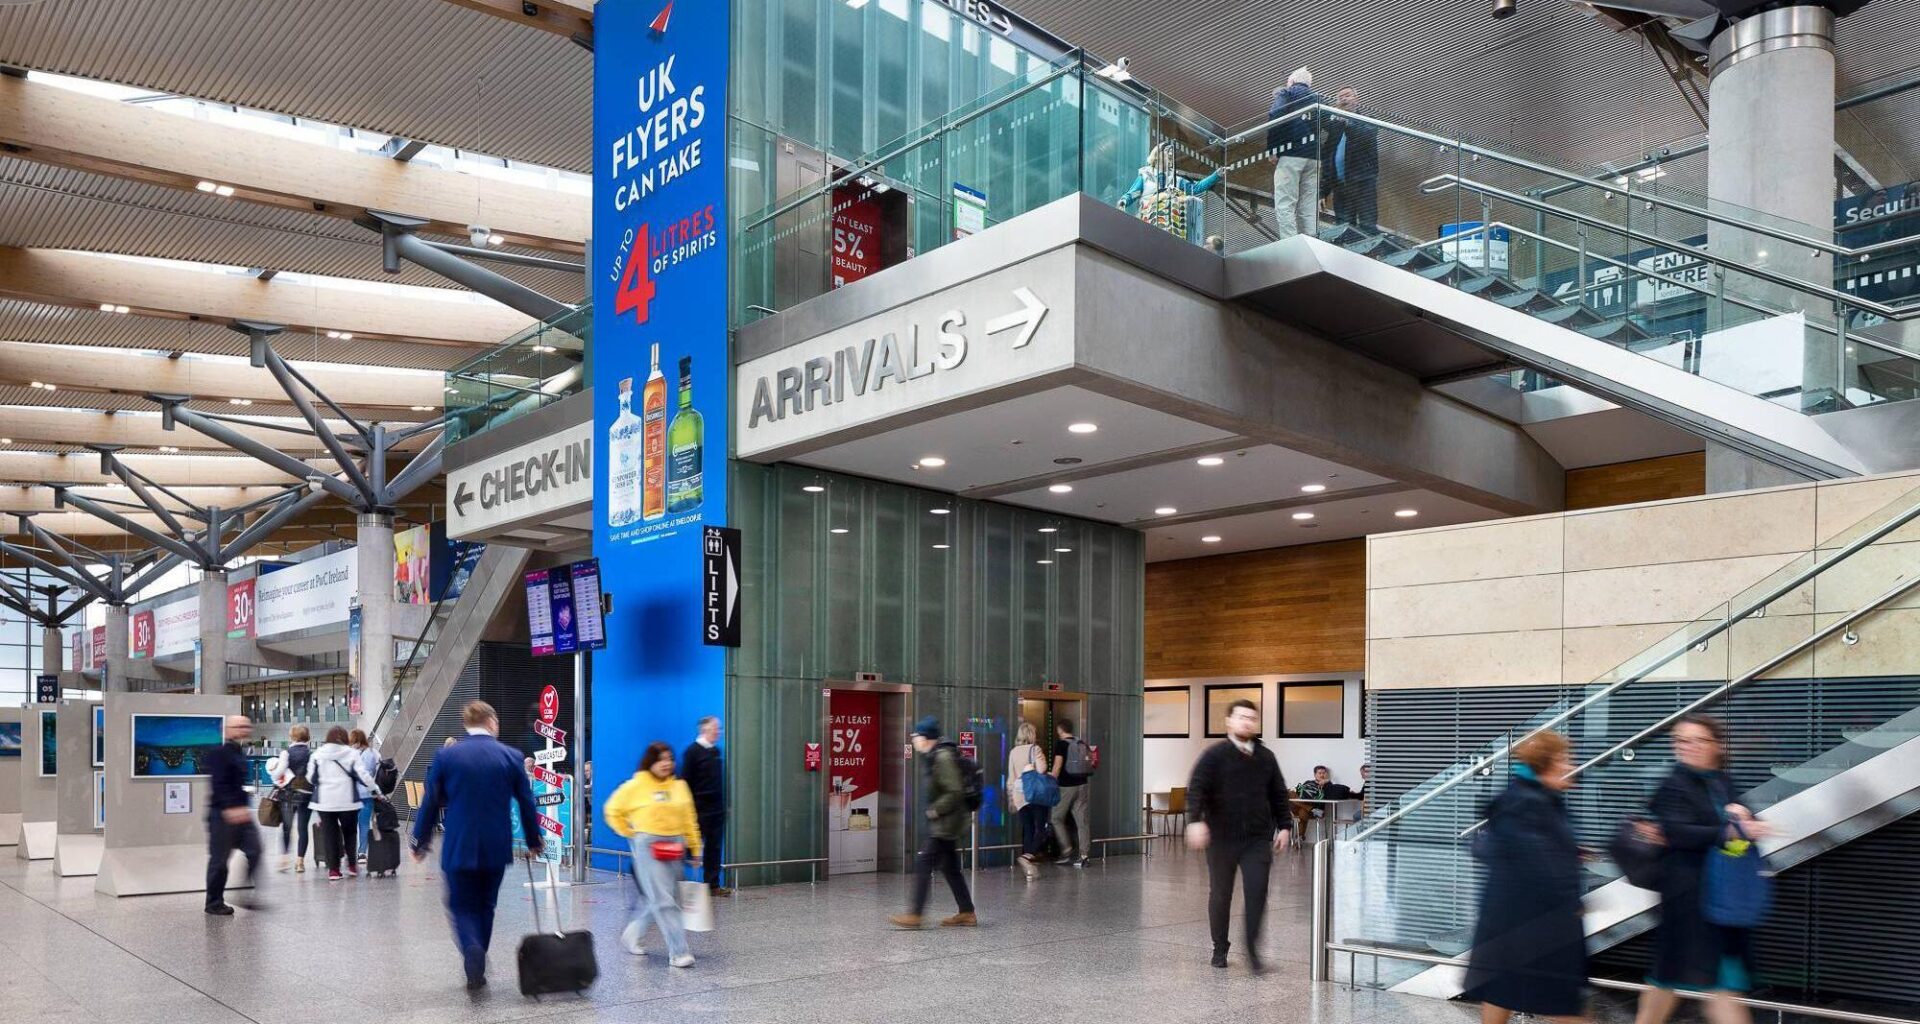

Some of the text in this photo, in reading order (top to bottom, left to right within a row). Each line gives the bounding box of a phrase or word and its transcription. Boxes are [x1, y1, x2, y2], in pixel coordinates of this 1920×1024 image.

[639, 53, 676, 113] UK
[612, 85, 705, 180] FLYERS
[614, 138, 702, 212] CAN TAKE
[1845, 192, 1920, 224] Securi
[651, 204, 715, 259] LITRES
[836, 215, 847, 225] AT
[849, 218, 873, 235] LEAST
[610, 228, 634, 282] UP TO
[653, 230, 717, 274] OF SPIRITS
[834, 227, 864, 260] 5%
[614, 222, 656, 326] 4
[835, 256, 868, 274] BEAUTY
[748, 309, 968, 429] ARRIVALS
[479, 438, 591, 510] CHECK-IN
[630, 529, 641, 537] AND
[640, 526, 653, 535] SHOP
[653, 522, 670, 533] ONLINE
[258, 585, 282, 603] Reimagine
[281, 583, 293, 600] your
[293, 580, 309, 593] career
[309, 578, 315, 590] at
[315, 572, 328, 588] PwC
[328, 565, 349, 585] Ireland
[708, 559, 719, 640] LIFTS
[540, 724, 557, 740] ROME
[835, 715, 846, 724] AT
[847, 715, 872, 725] LEAST
[536, 750, 564, 761] NEWCASTLE
[832, 728, 862, 753] 5%
[541, 770, 557, 785] FARO
[834, 757, 866, 766] BEAUTY
[538, 794, 562, 805] VALENCIA
[540, 816, 557, 832] PARIS
